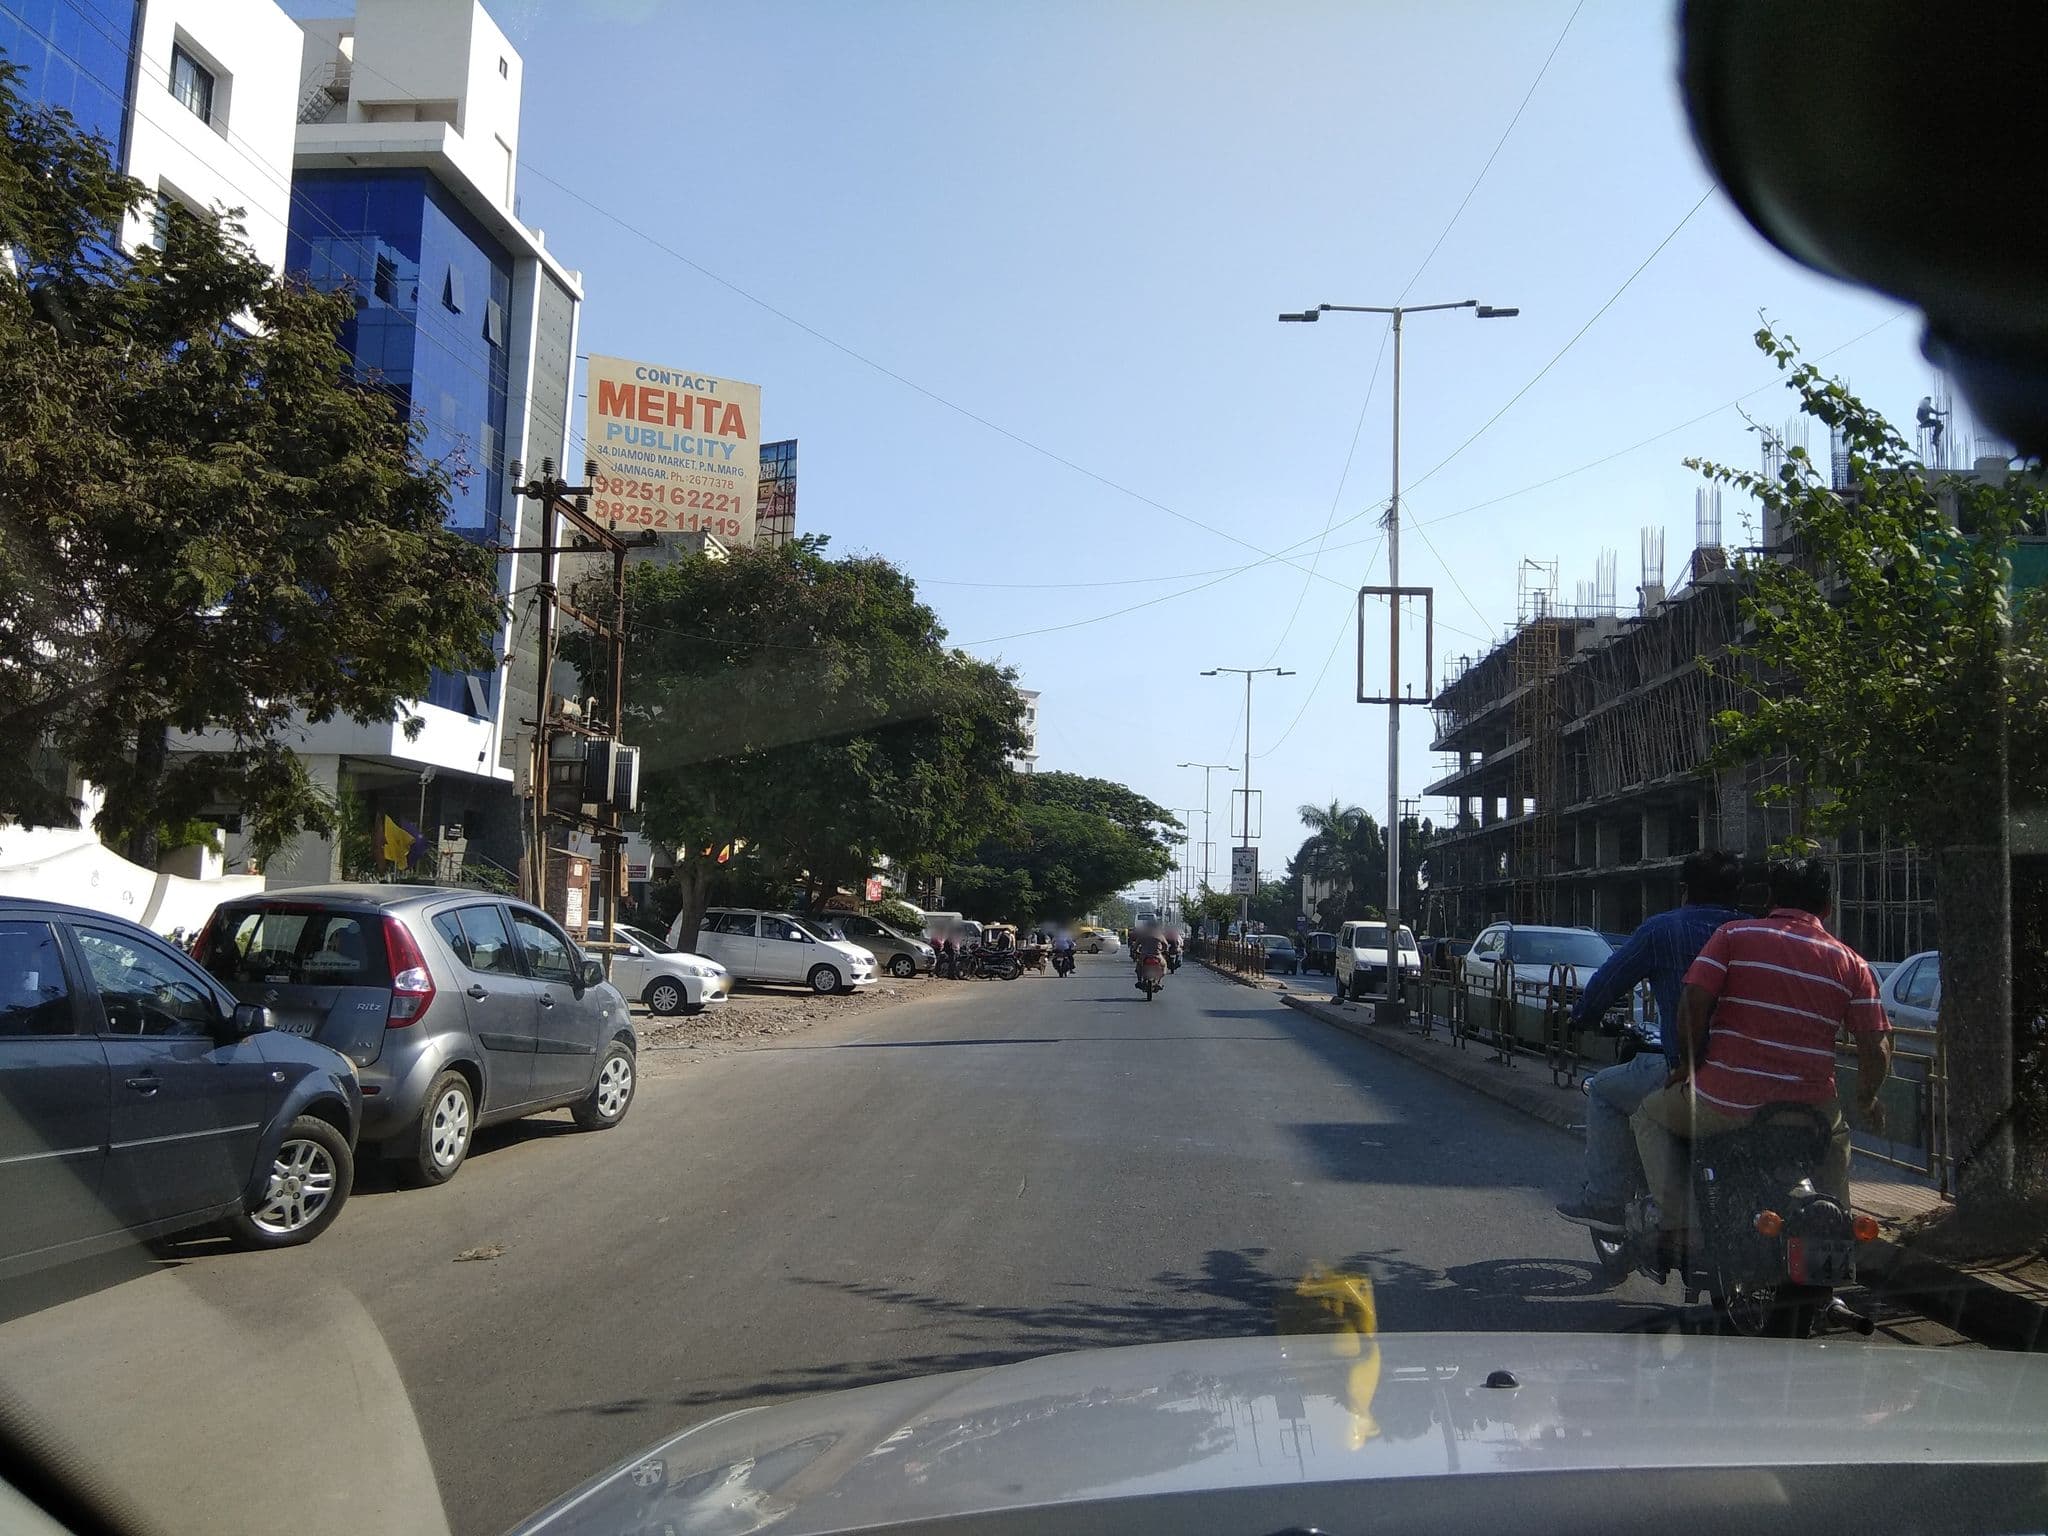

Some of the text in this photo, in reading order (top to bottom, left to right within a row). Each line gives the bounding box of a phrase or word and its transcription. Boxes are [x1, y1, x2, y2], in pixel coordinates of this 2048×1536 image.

[635, 366, 718, 393] CONTACT
[598, 379, 747, 440] MEHTA
[606, 422, 737, 460] PUBLICITY
[356, 1003, 382, 1011] Ritz
